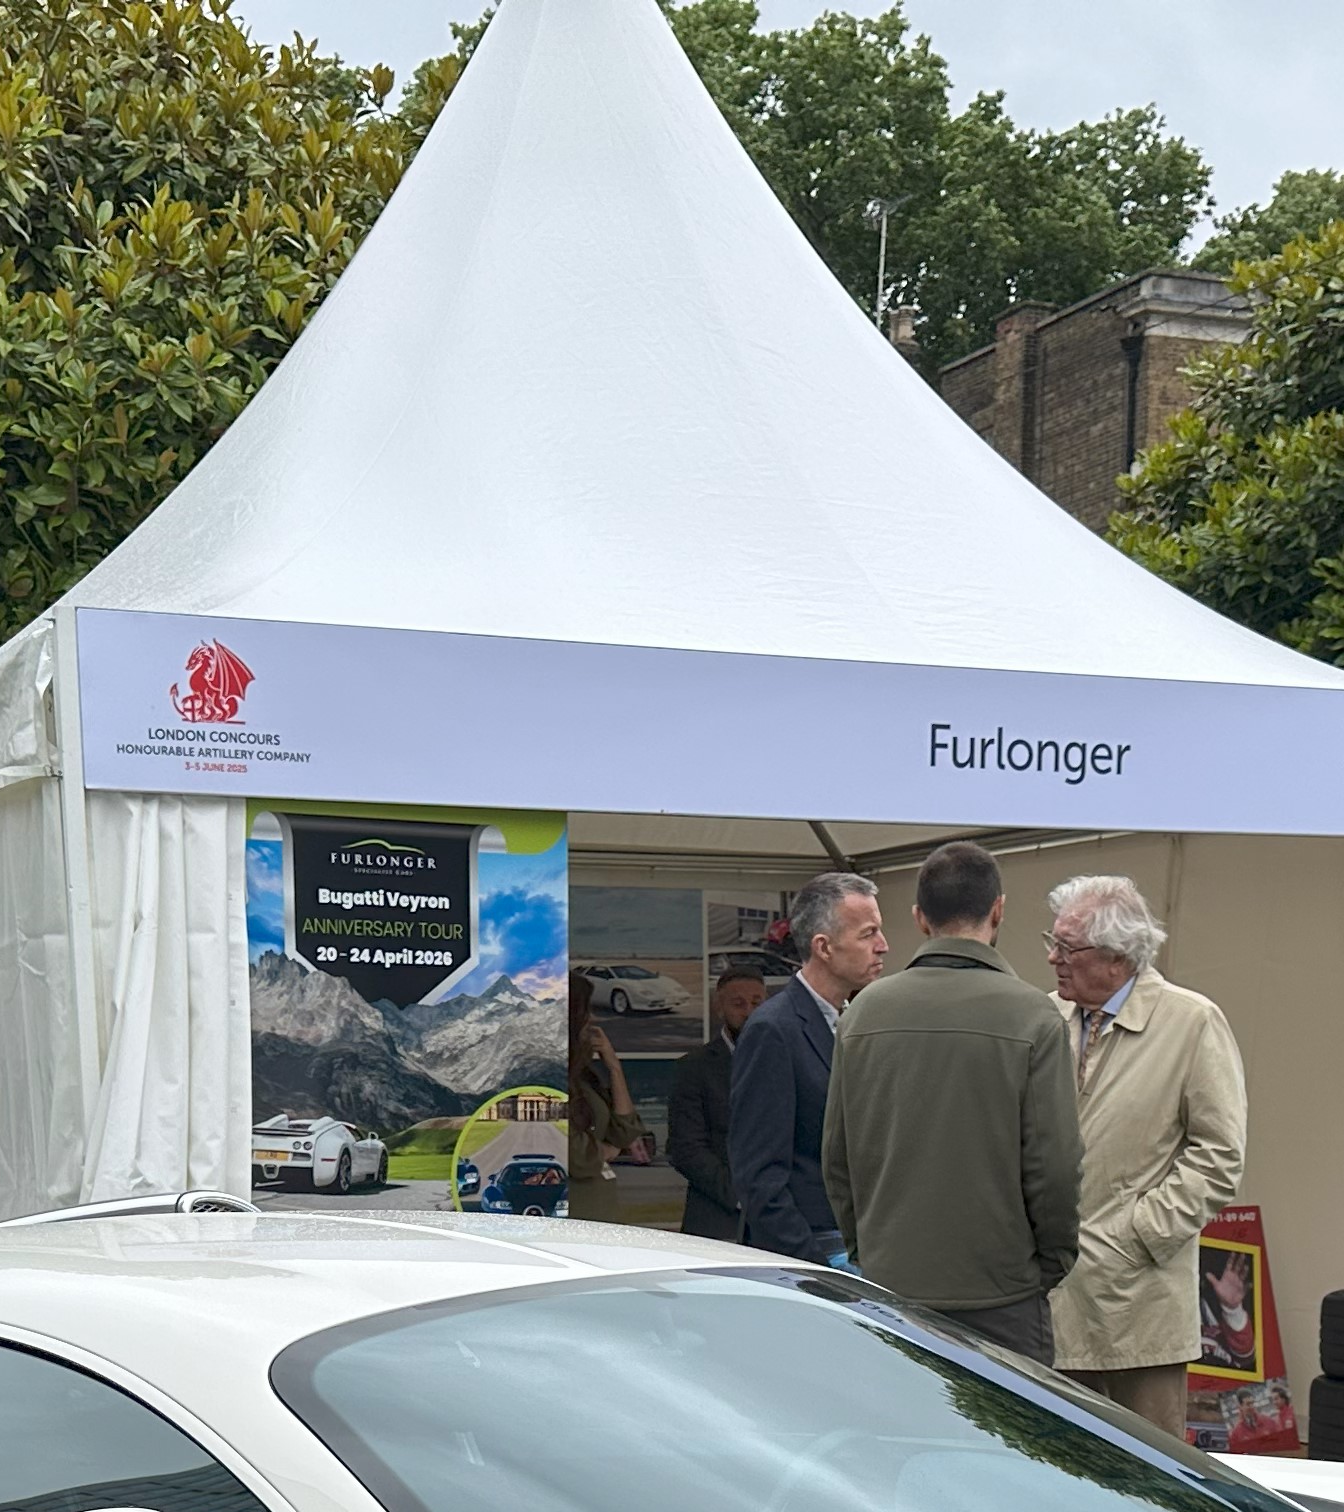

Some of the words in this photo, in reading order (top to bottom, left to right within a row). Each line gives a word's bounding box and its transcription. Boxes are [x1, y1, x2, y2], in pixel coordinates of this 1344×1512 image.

[147, 728, 205, 742] LONDON
[209, 731, 281, 746] CONCOURS
[116, 744, 196, 758] HONOURABLE
[197, 747, 255, 760] ARTILLERY
[256, 751, 312, 763] COMPANY
[928, 723, 1132, 785] Furlonger
[202, 763, 225, 772] JUNE
[330, 853, 437, 868] FURLONGER
[318, 888, 384, 909] Bugatti
[386, 892, 450, 913] Veyron
[302, 917, 414, 937] ANNIVERSARY
[419, 921, 464, 940] TOUR
[316, 946, 338, 962] 20
[349, 948, 371, 964] 24
[372, 949, 413, 969] April
[414, 950, 454, 967] 2026
